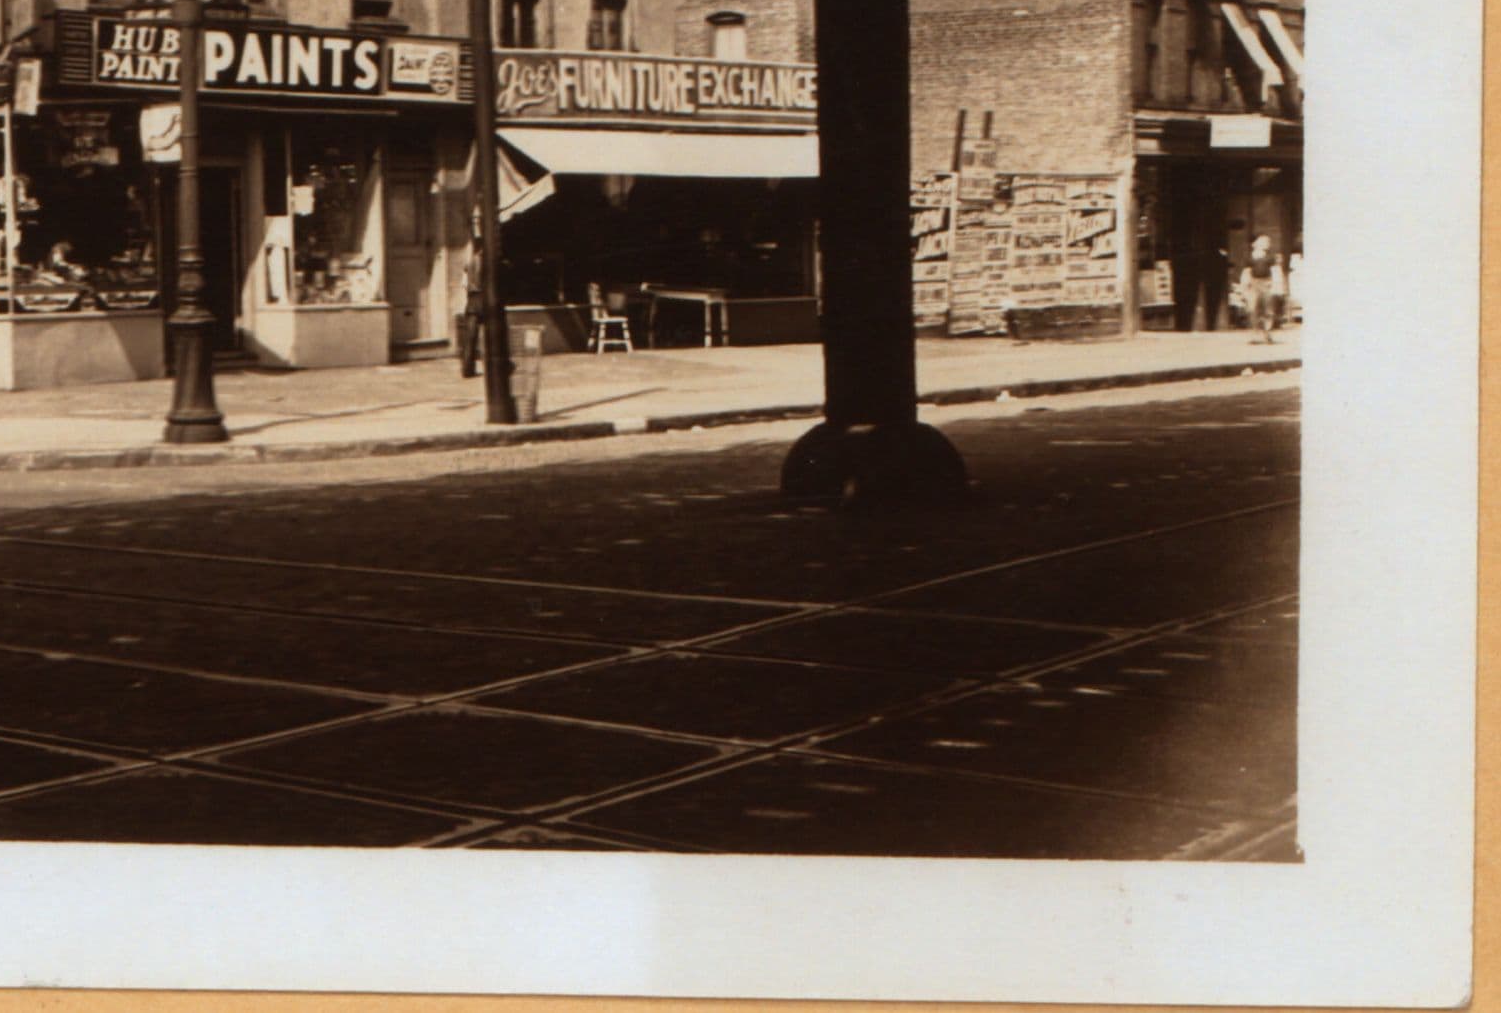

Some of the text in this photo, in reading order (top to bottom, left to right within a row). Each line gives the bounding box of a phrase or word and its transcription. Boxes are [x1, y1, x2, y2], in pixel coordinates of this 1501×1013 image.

[111, 24, 181, 55] HUB
[203, 30, 379, 90] PAINTS
[98, 51, 182, 82] PAINT
[558, 58, 696, 114] FURNITURE
[697, 66, 819, 109] EXCHANGE
